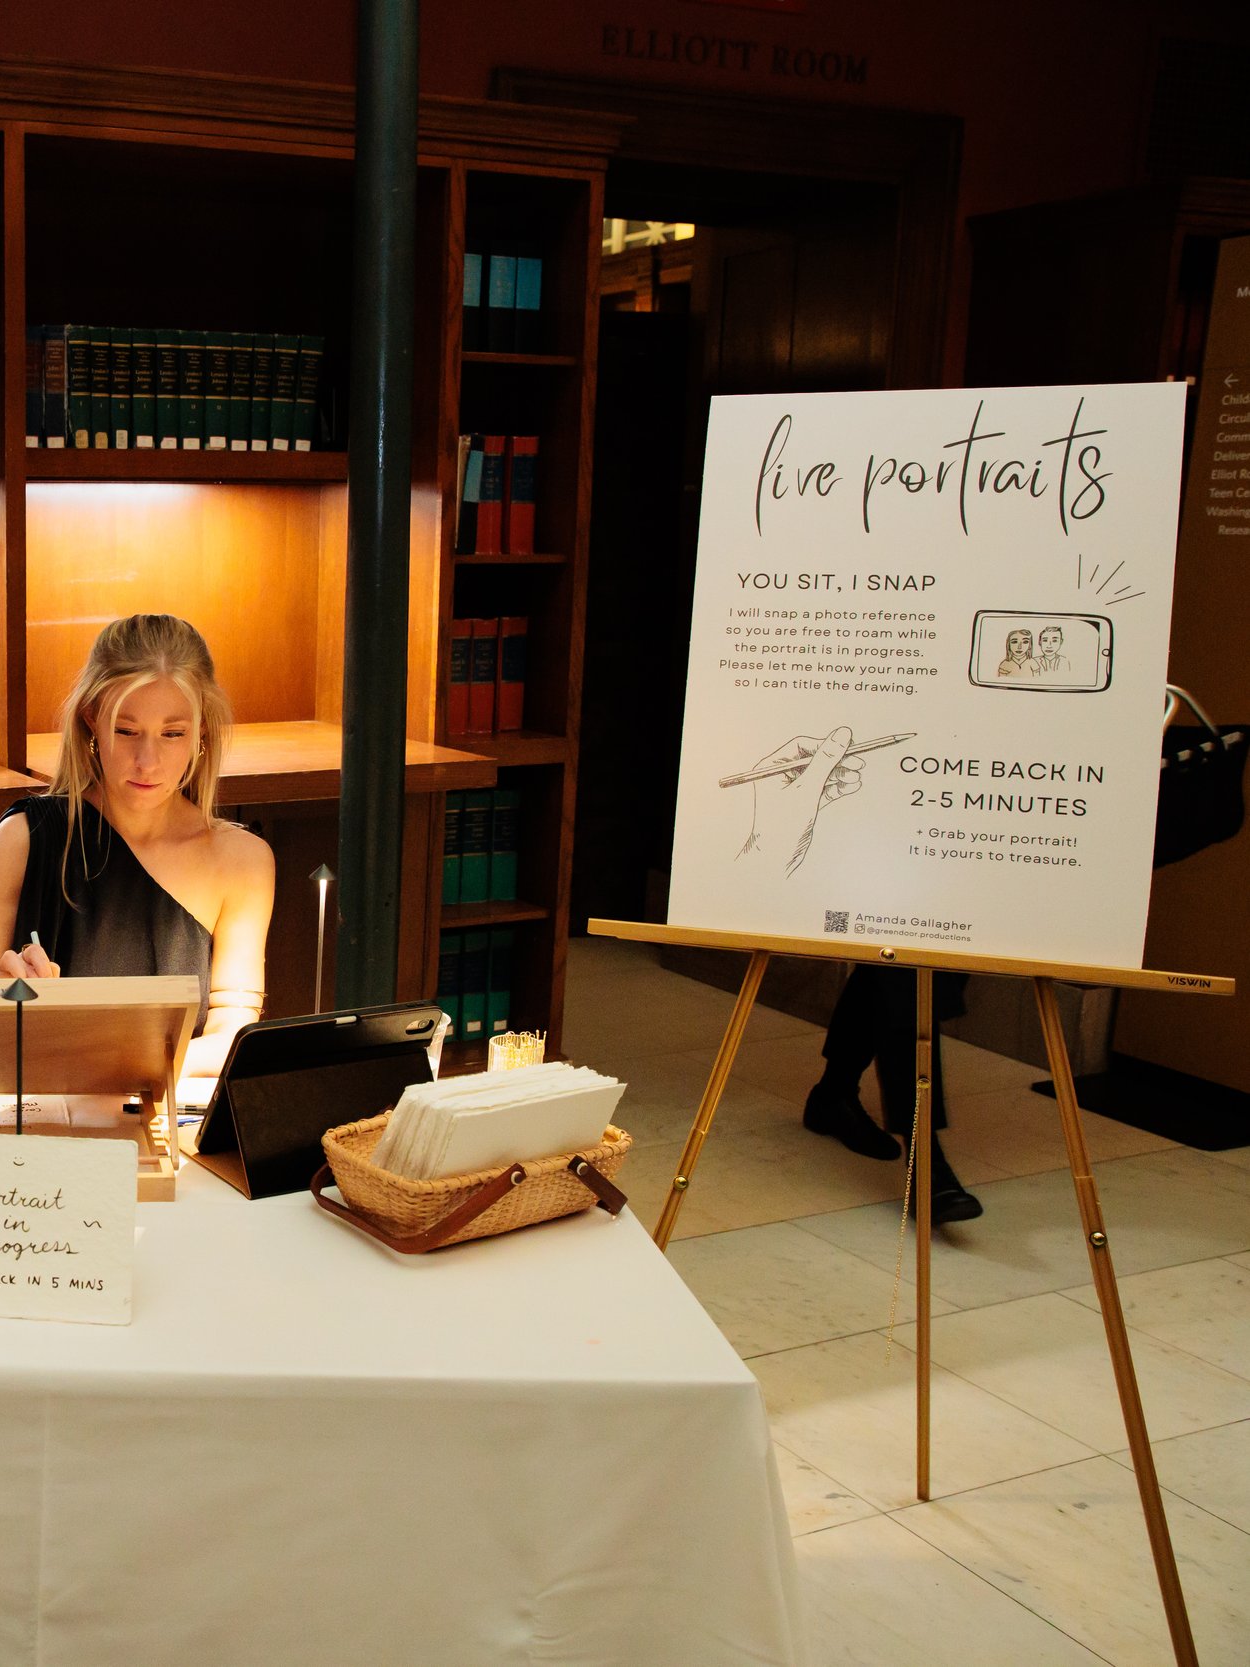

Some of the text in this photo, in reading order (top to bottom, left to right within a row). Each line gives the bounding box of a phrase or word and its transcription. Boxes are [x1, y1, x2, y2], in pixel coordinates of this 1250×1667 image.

[601, 22, 868, 85] ELLIOTT ROOM
[755, 396, 1114, 537] live portraits
[737, 572, 936, 593] YOU SIT, I SNAP
[728, 607, 936, 622] I will snap a photo reference
[725, 625, 937, 640] so you are free to roam while
[734, 642, 925, 659] the portrait is in progress.
[719, 659, 938, 676] Please let me know your name
[734, 678, 918, 696] so I can title the drawing.
[899, 756, 1104, 784] COME BACK IN
[910, 789, 1087, 817] 2-5 MINUTES
[916, 827, 1077, 848] + Grab your portrait!
[908, 844, 1082, 867] It is yours to treasure.
[855, 912, 973, 932] Amanda Gallagher
[867, 926, 971, 942] @greendoor.productions
[1167, 976, 1211, 988] VISWIN
[3, 1214, 30, 1232] in
[27, 1275, 41, 1286] IN
[51, 1276, 59, 1289] 5
[69, 1278, 104, 1291] MINS
